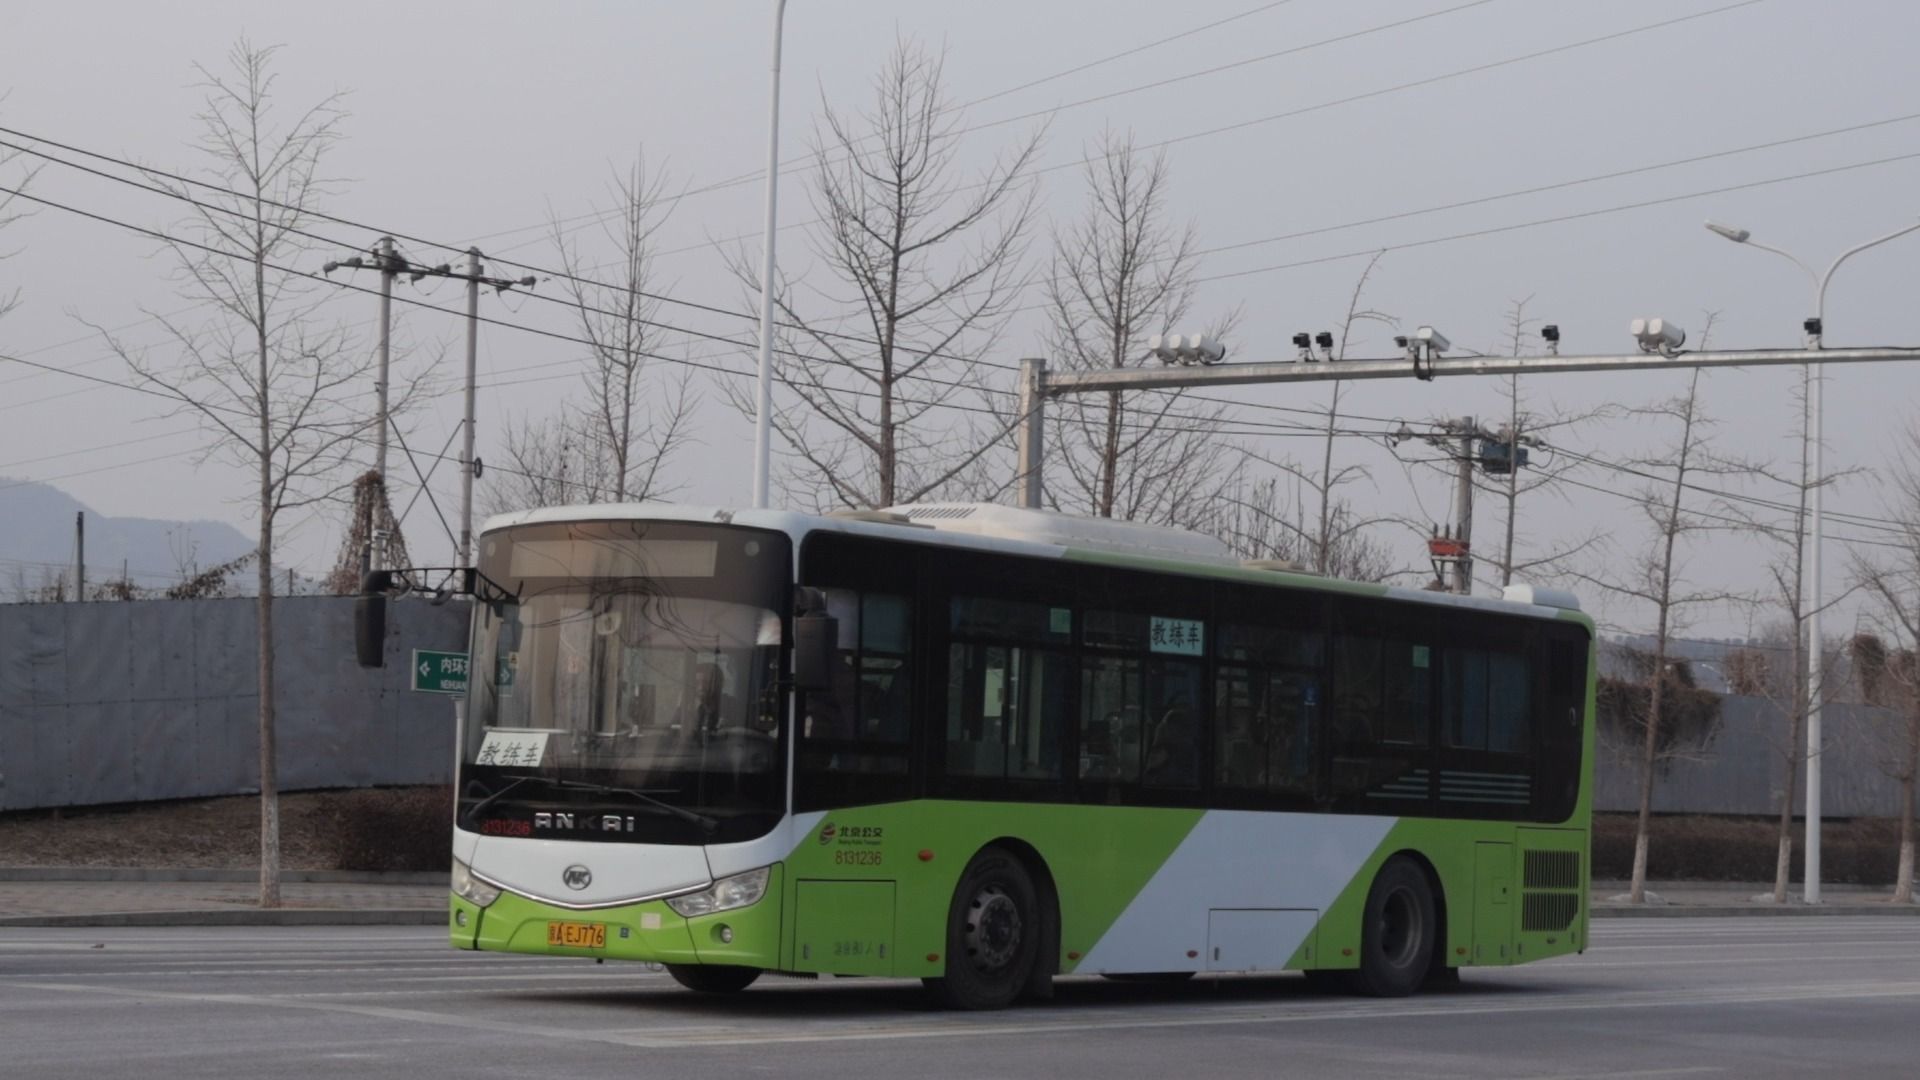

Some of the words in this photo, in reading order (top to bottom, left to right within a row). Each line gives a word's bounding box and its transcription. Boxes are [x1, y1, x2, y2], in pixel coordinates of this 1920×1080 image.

[1151, 620, 1200, 649] 教练车
[480, 741, 539, 767] 教练车
[839, 826, 883, 838] 北京公交
[835, 850, 882, 866] 8131236
